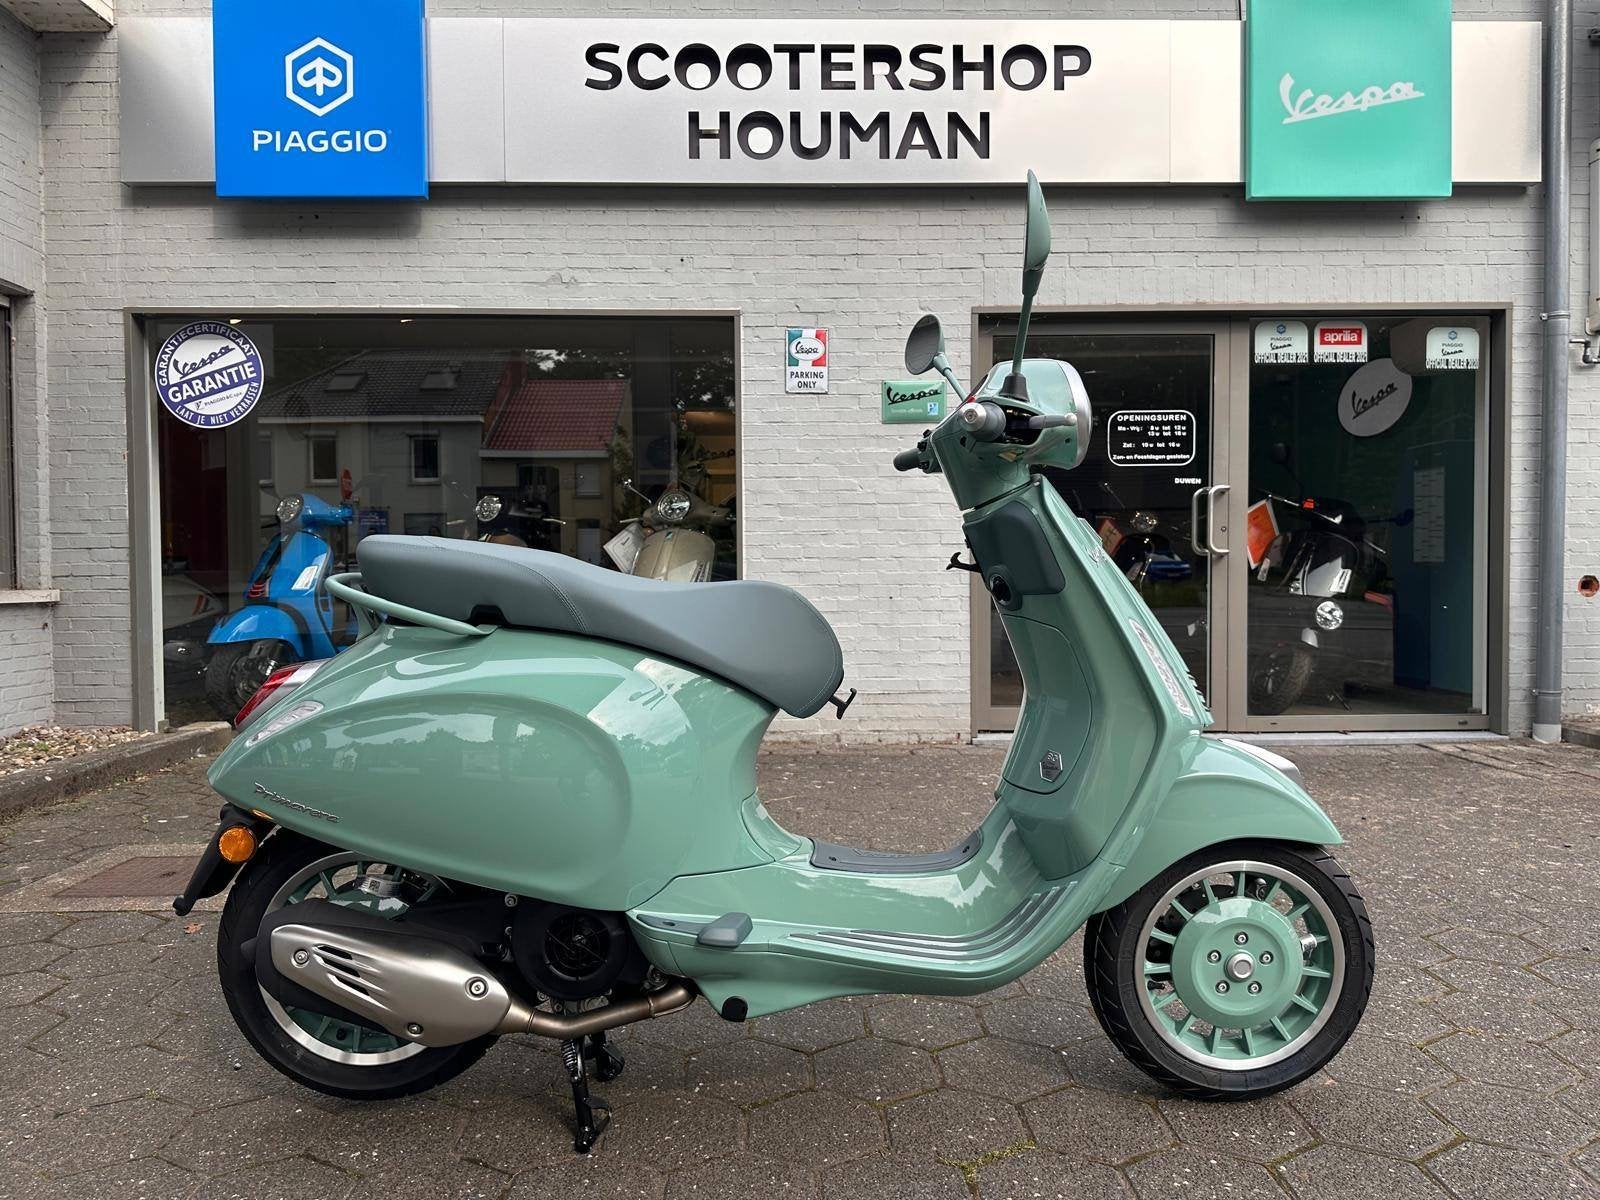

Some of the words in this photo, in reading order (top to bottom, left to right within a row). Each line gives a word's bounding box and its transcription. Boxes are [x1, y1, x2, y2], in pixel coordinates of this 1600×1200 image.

[584, 43, 1092, 91] SCOOTERSHOP
[1279, 72, 1425, 124] Vespa
[252, 129, 388, 152] PIAGGIO
[688, 110, 990, 160] HOUMAN
[795, 340, 819, 355] Vespa
[1323, 329, 1358, 344] aprilia
[158, 323, 256, 387] GARANTIECERTIFICAAT
[172, 344, 236, 381] Vespa
[1254, 352, 1276, 363] OFFICIAL
[1278, 352, 1296, 363] DEALER
[1314, 352, 1336, 362] OFFICIAL
[1336, 352, 1356, 362] DEALER
[1426, 358, 1447, 369] OFFICIAL
[1448, 358, 1467, 369] DEALER
[168, 362, 257, 403] GARANTIE
[790, 371, 824, 379] PARKING
[797, 380, 817, 388] ONLY
[175, 405, 193, 420] LAAT
[196, 415, 205, 425] JE
[211, 415, 228, 425] NIET
[230, 382, 260, 418] VERRASSEN
[886, 386, 942, 406] Vespa
[1351, 382, 1398, 420] Vespa
[254, 781, 341, 823] Primavera
